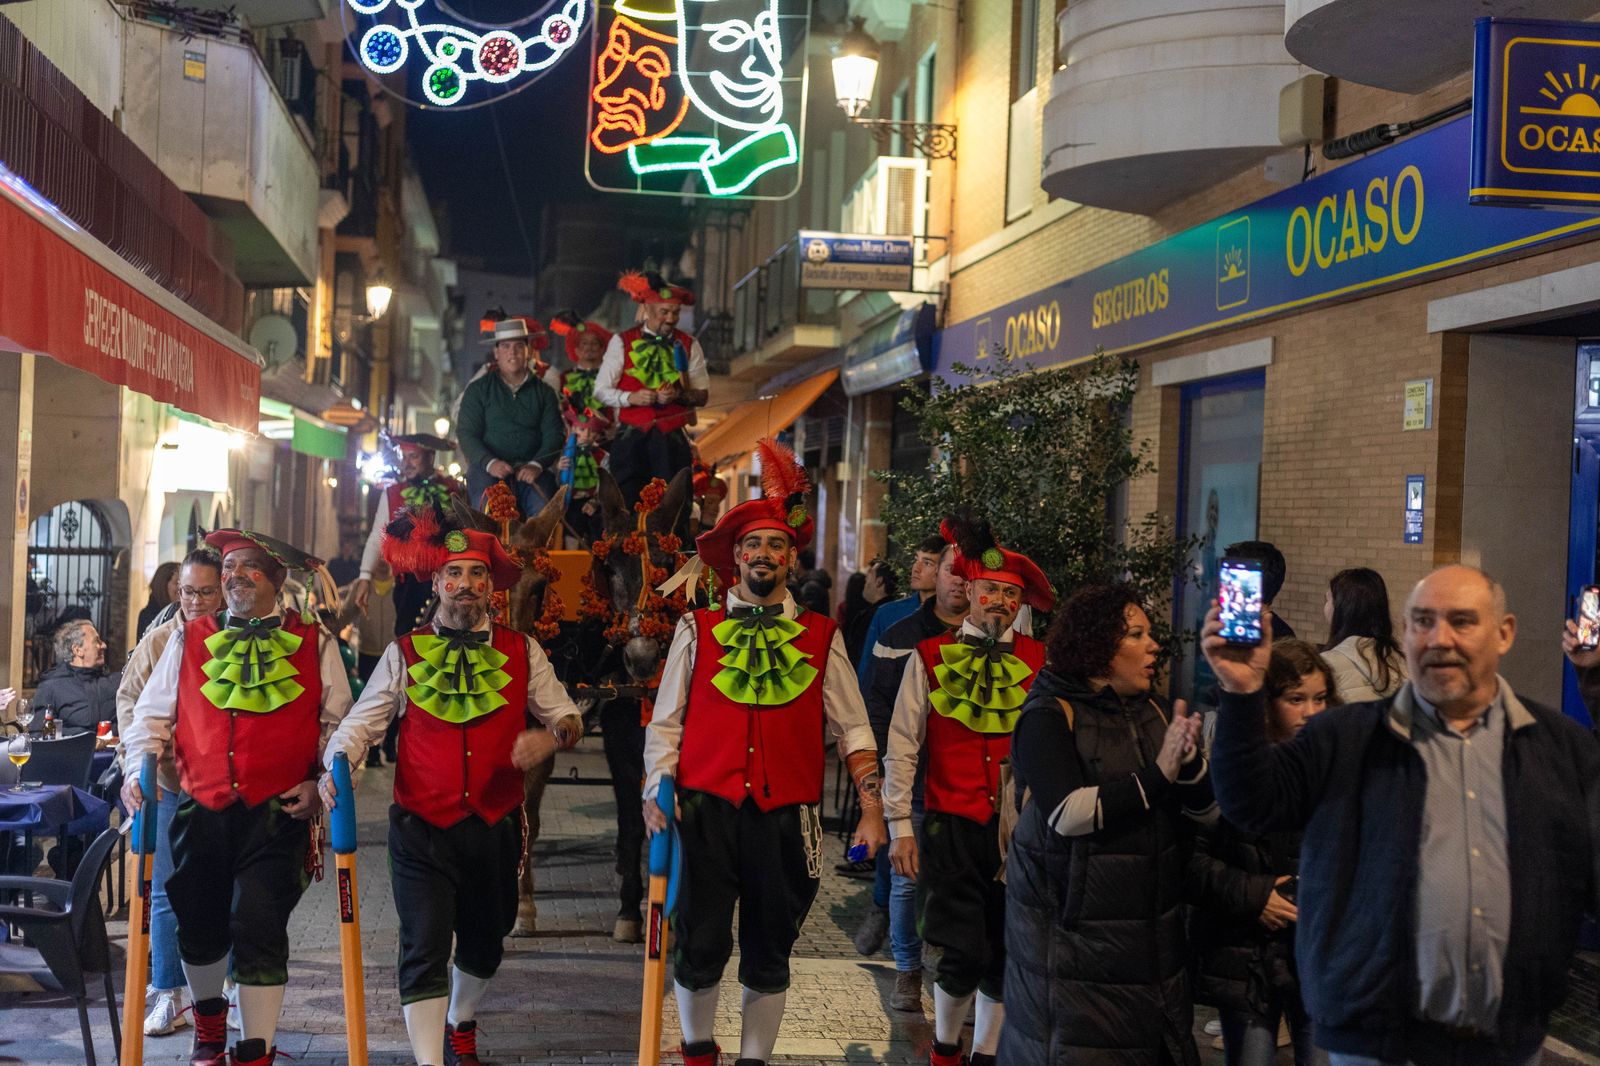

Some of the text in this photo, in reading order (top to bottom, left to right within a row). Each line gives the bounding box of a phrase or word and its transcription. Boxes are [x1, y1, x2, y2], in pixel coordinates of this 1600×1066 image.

[1286, 164, 1424, 277] OCASO
[1004, 268, 1169, 362] OCASO SEGUROS
